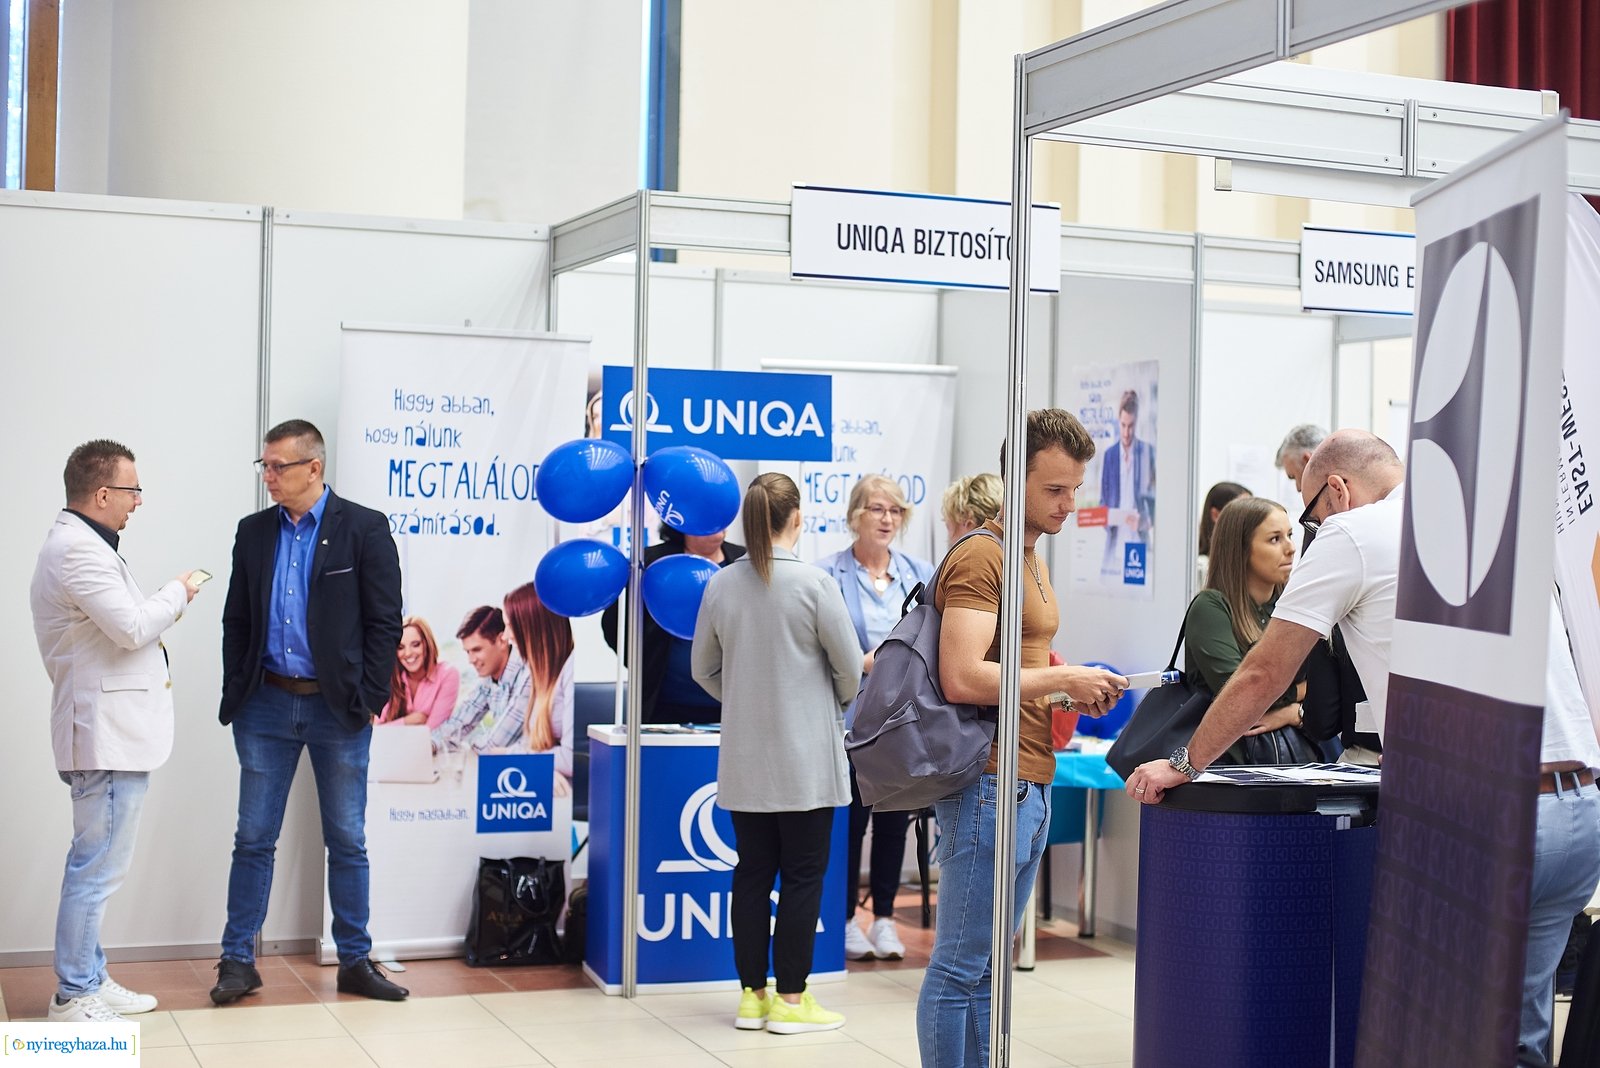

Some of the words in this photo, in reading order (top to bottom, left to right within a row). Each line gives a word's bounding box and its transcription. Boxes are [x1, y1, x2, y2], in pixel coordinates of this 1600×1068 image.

[837, 223, 905, 254] UNIQA
[1314, 260, 1399, 288] SAMSUNG
[394, 388, 434, 413] Higgy
[441, 395, 495, 416] abban,
[682, 397, 825, 438] UNIQA
[365, 428, 398, 445] hogy
[404, 420, 462, 448] nálunk
[804, 467, 926, 505] MEGTOD
[389, 508, 500, 536] számításod.
[482, 802, 547, 820] UNIQA
[637, 891, 825, 942] UNI
